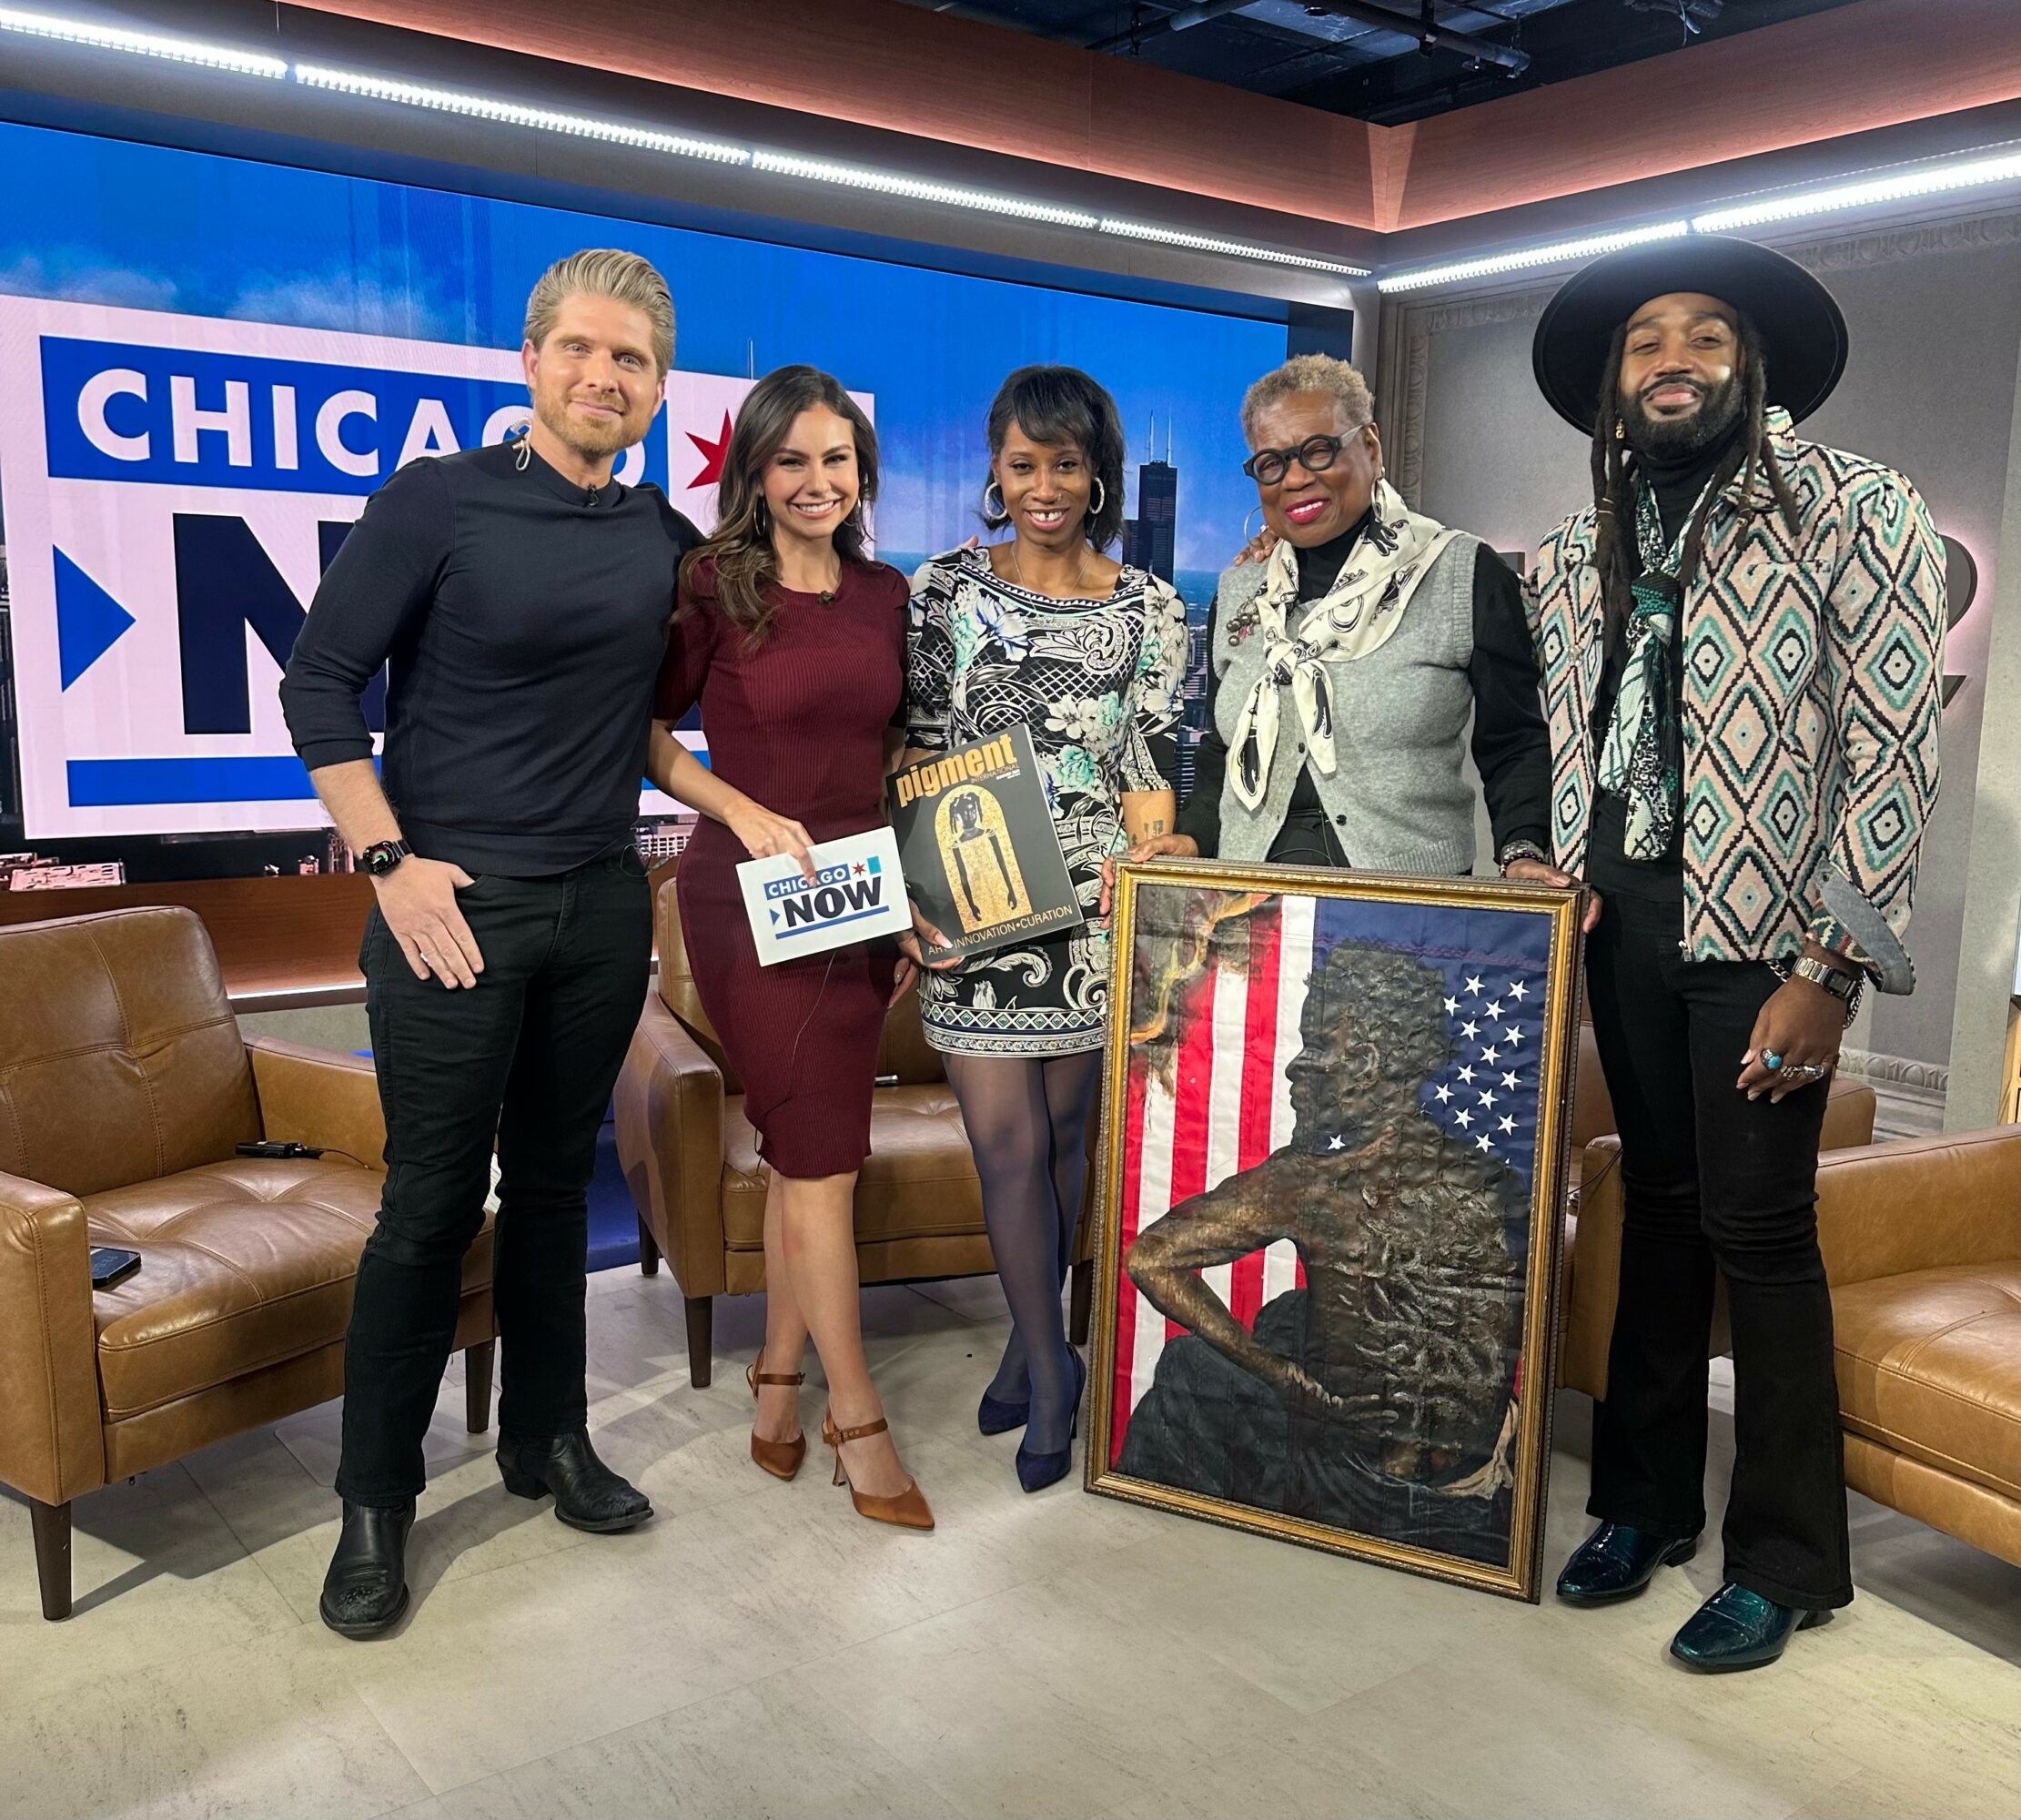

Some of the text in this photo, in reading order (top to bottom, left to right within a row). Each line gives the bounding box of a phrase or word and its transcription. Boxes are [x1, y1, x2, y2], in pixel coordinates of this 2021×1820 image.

[895, 733, 1017, 808] pigment
[970, 763, 1020, 784] INTERNATIONAL
[783, 875, 882, 928] NOW
[954, 922, 1016, 949] INNOVATION
[1019, 905, 1073, 929] CURATION
